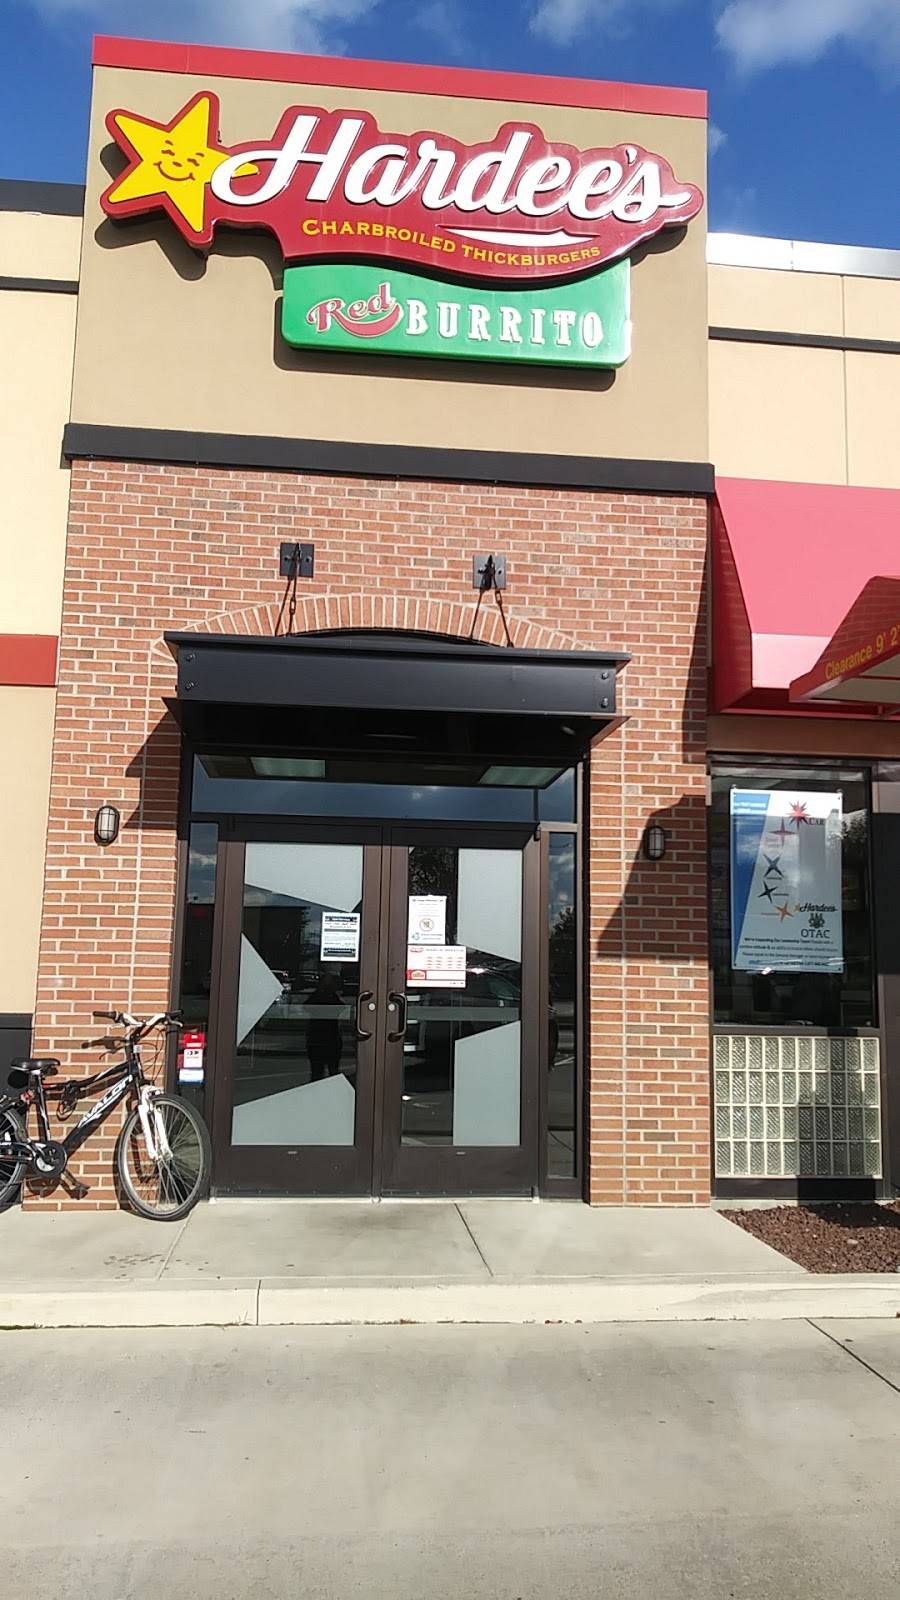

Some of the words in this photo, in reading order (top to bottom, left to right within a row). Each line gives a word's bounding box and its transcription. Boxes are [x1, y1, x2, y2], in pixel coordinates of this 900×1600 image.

[211, 114, 692, 222] Hardee's
[302, 218, 456, 254] CHARBROILED
[461, 245, 601, 267] THICKBURGERS
[306, 282, 404, 338] Red
[406, 299, 605, 348] BURRITO
[825, 644, 873, 680] Clearance
[801, 928, 830, 939] OTAC
